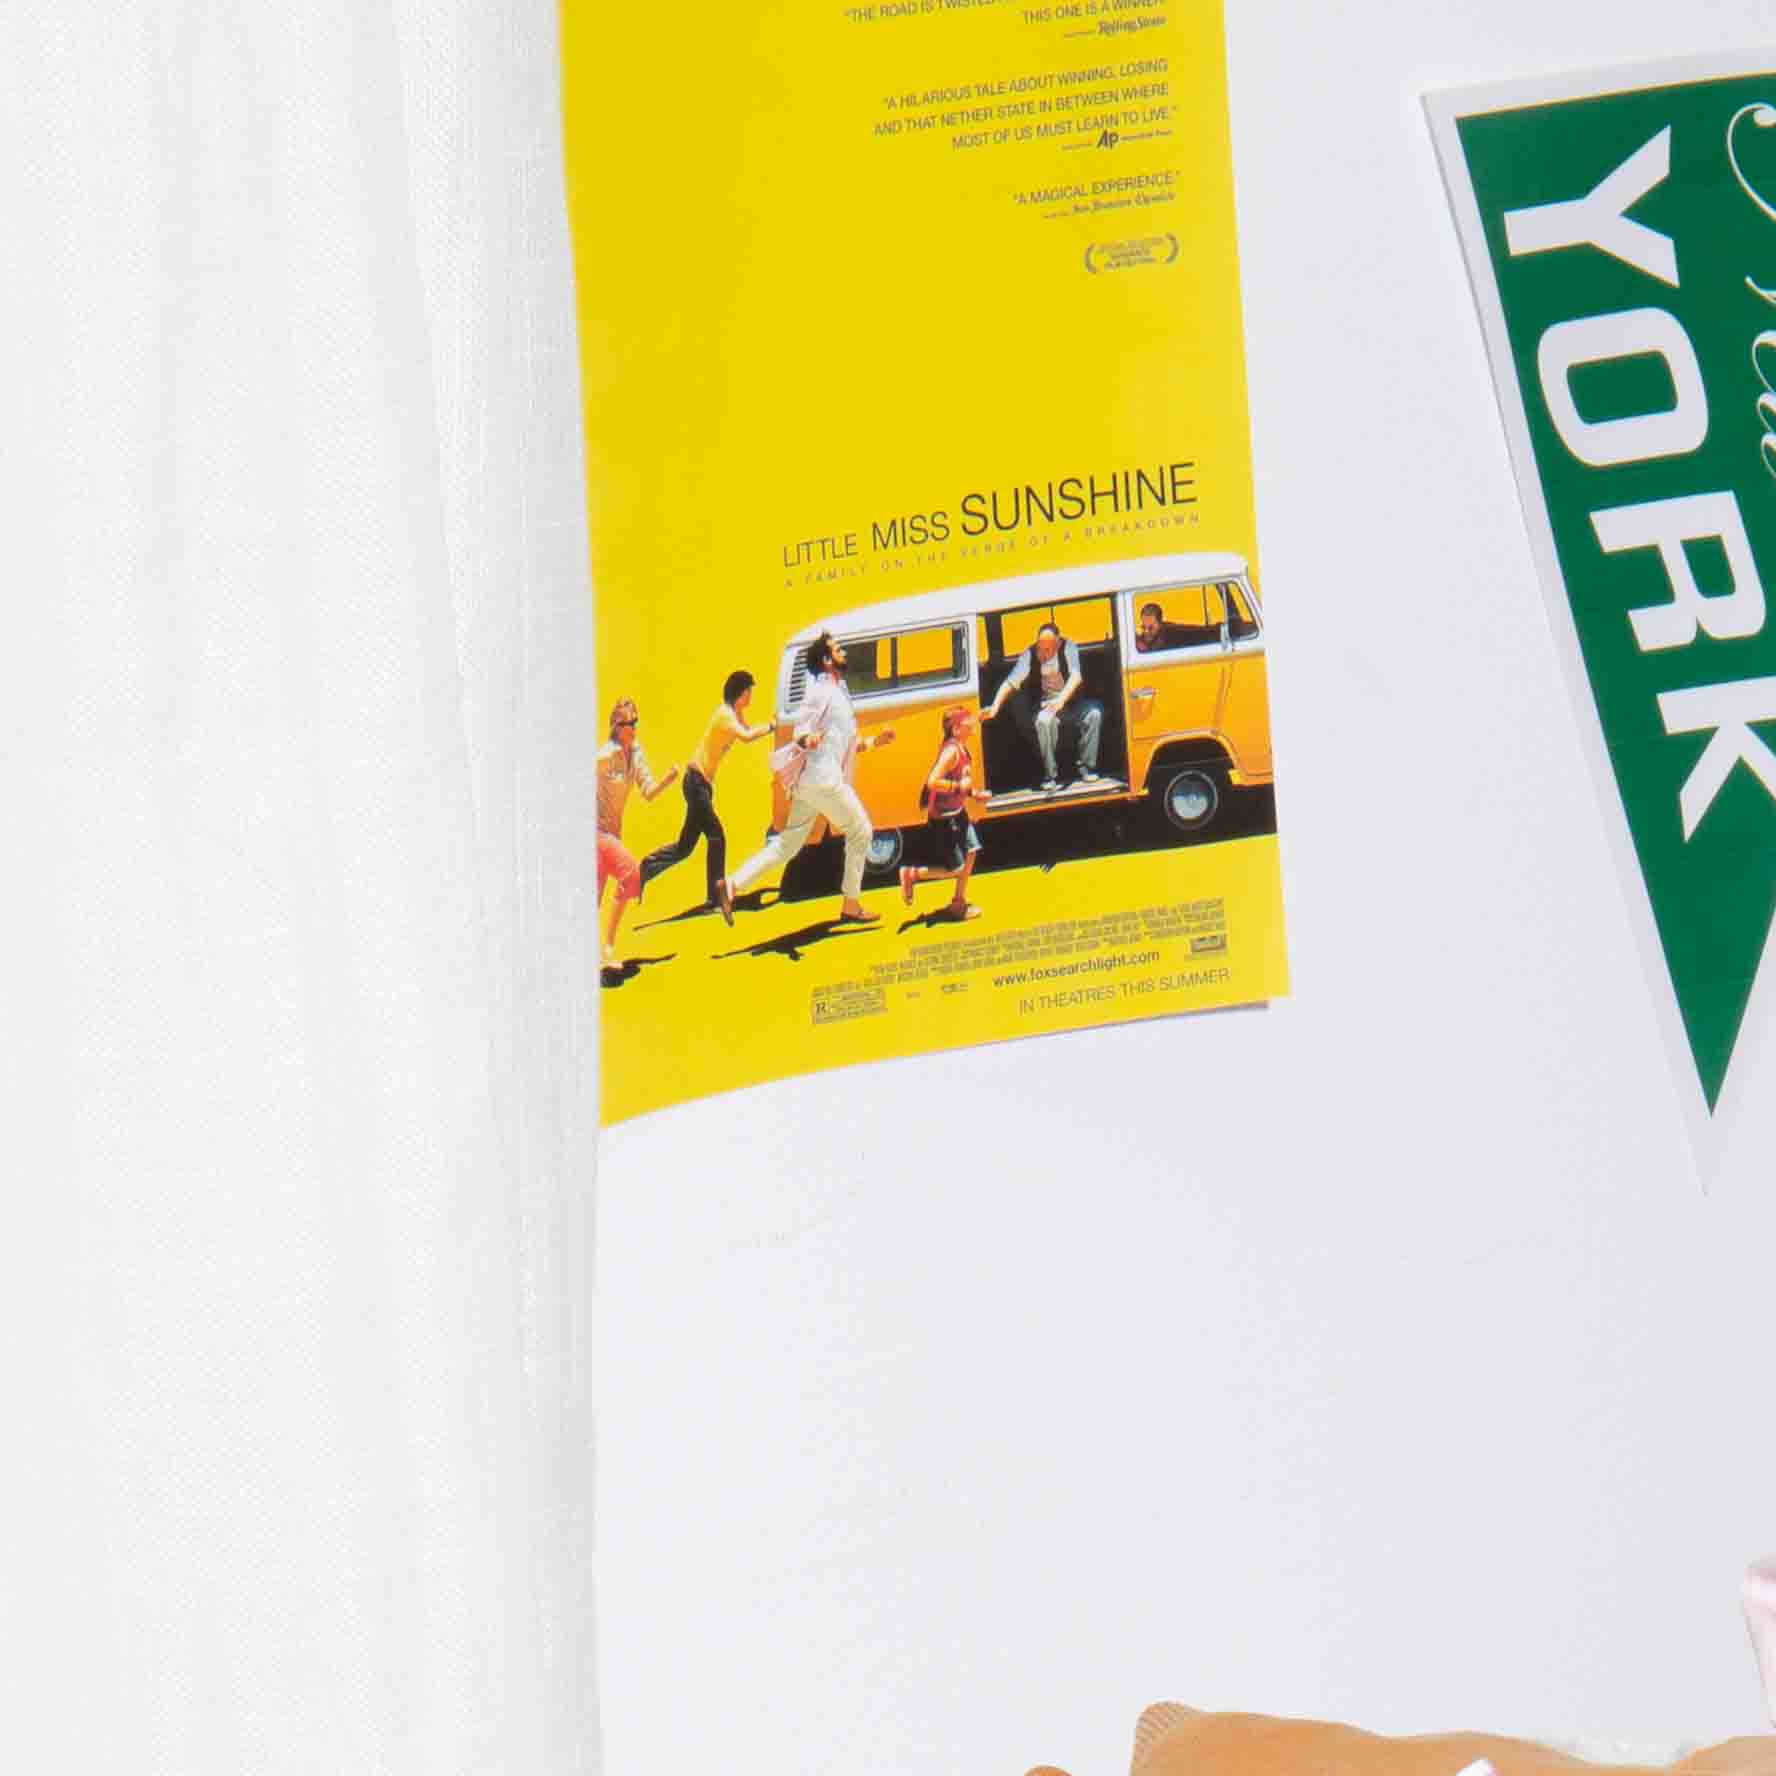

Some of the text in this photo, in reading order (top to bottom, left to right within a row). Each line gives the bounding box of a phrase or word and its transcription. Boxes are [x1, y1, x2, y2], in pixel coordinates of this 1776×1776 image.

[1023, 8, 1050, 24] THIS
[1056, 5, 1082, 18] ONE
[900, 85, 971, 108] HILARIOUS
[975, 81, 1007, 97] TALE
[1008, 74, 1055, 94] ABOUT
[1120, 57, 1168, 77] LOSING
[873, 82, 1168, 137] AND THAT NETHER STATE IN BETWEEN WHERE
[952, 131, 992, 152] MOST
[993, 128, 1009, 144] OF
[1015, 126, 1033, 141] US
[1037, 120, 1072, 137] MUST
[1077, 112, 1119, 131] LEARN
[1120, 110, 1138, 126] TO
[1030, 184, 1088, 205] MAGICAL
[783, 461, 1198, 568] LITTLE MISS SUNSHINE
[992, 951, 1160, 987] www.foxsearchlight.com
[1018, 967, 1231, 1015] IN THEATRES THIS SUMMER
